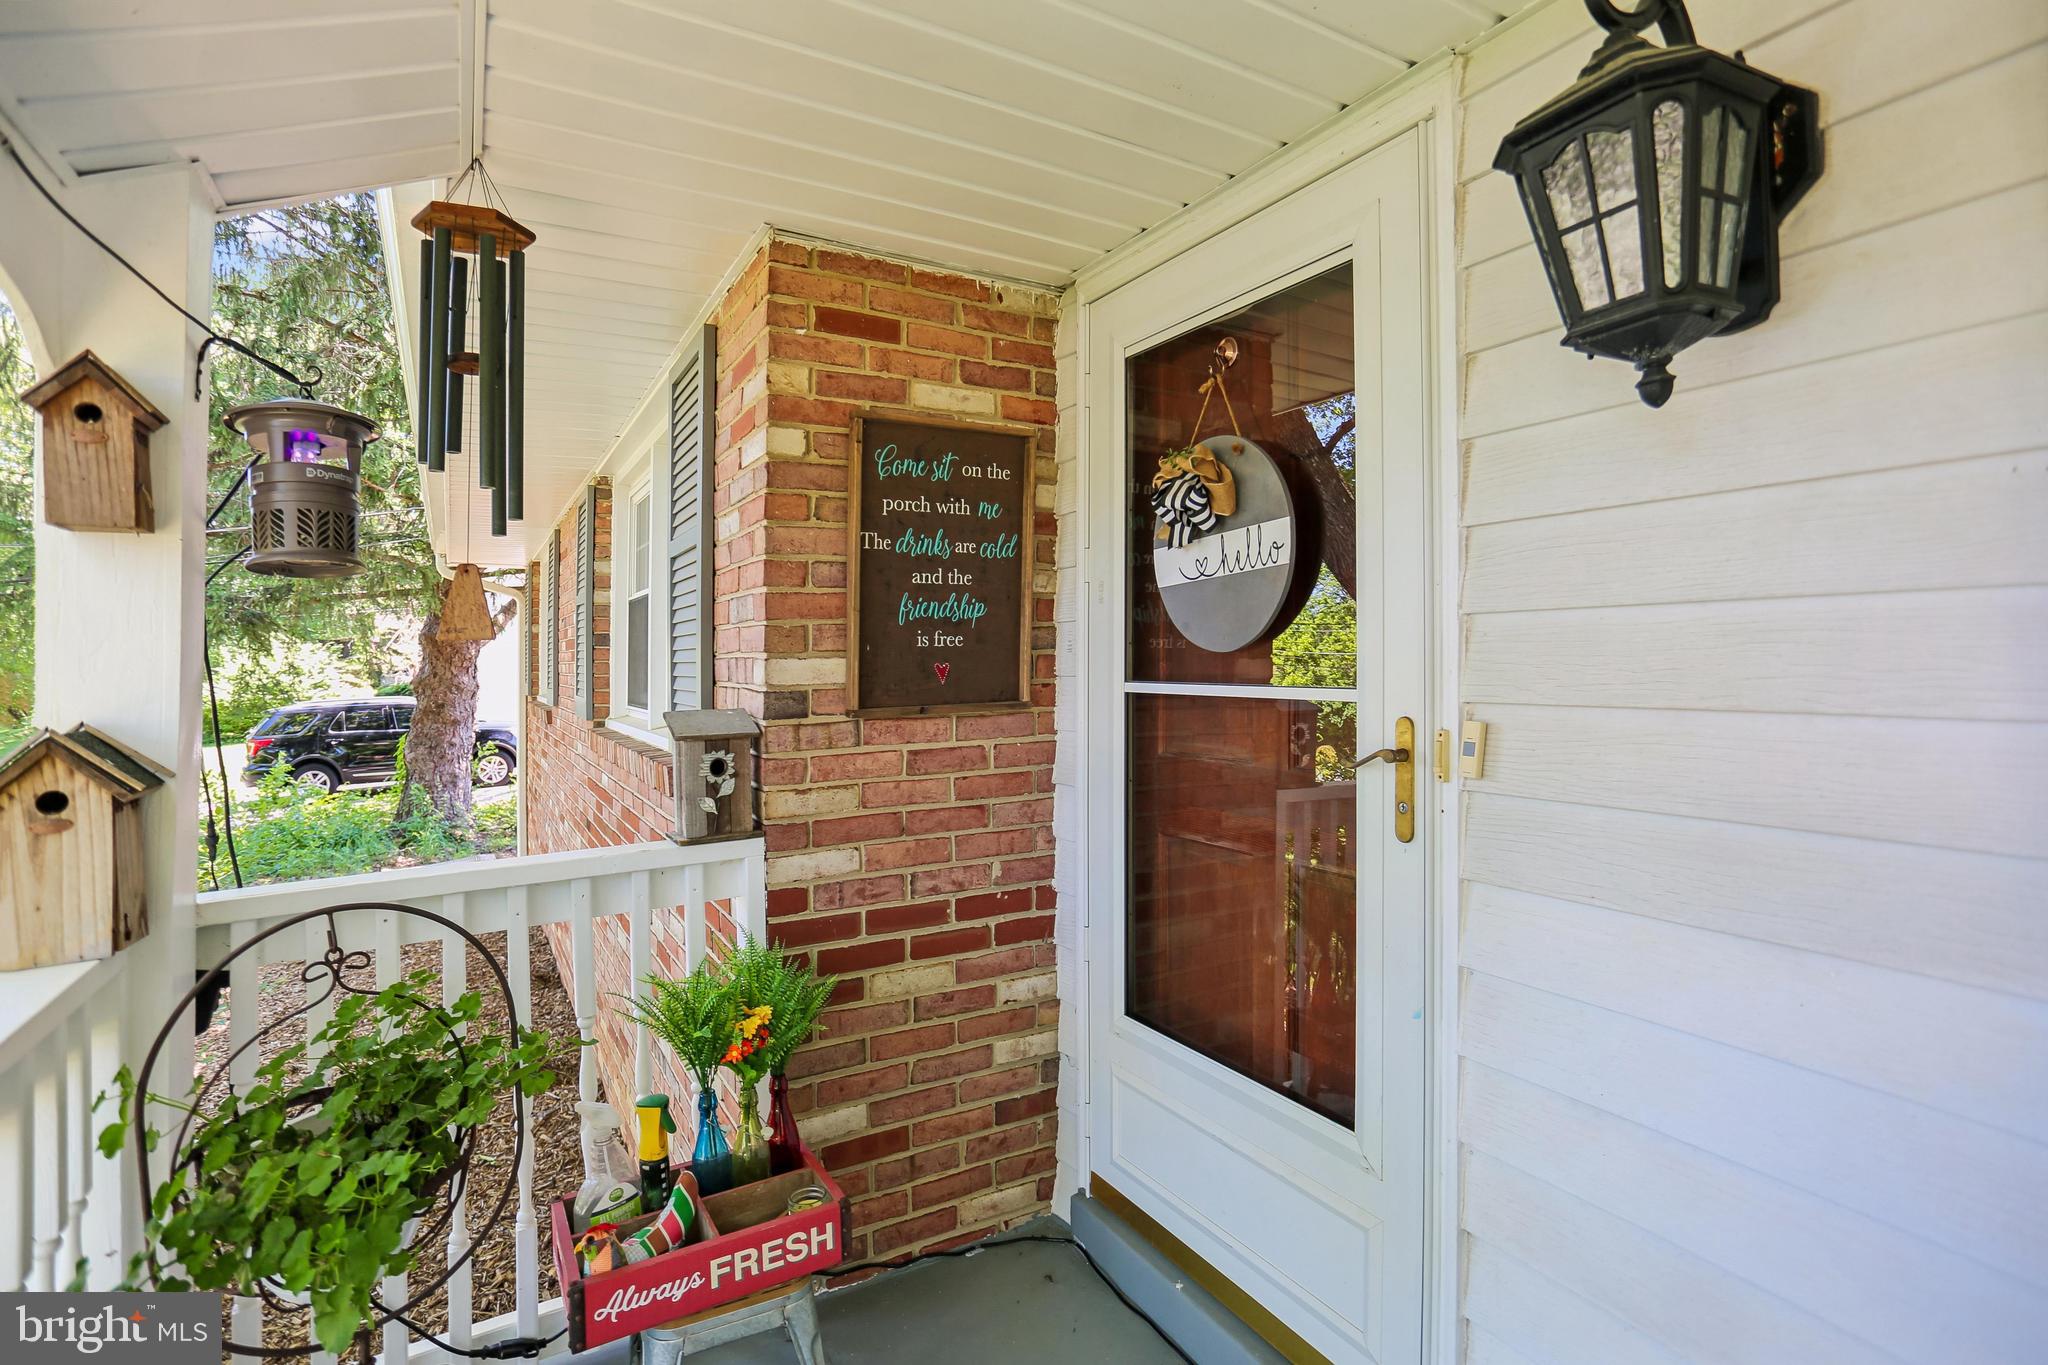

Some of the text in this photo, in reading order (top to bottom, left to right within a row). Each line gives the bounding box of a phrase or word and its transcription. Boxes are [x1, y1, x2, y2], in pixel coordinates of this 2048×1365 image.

[875, 444, 1011, 482] Come sit on the
[882, 496, 1002, 519] porch with me
[861, 528, 1018, 559] The drinks are cold
[1217, 524, 1285, 575] hello
[912, 568, 972, 585] and the
[898, 592, 987, 629] friendship
[916, 630, 964, 647] is free
[594, 1222, 835, 1323] Always FRESH
